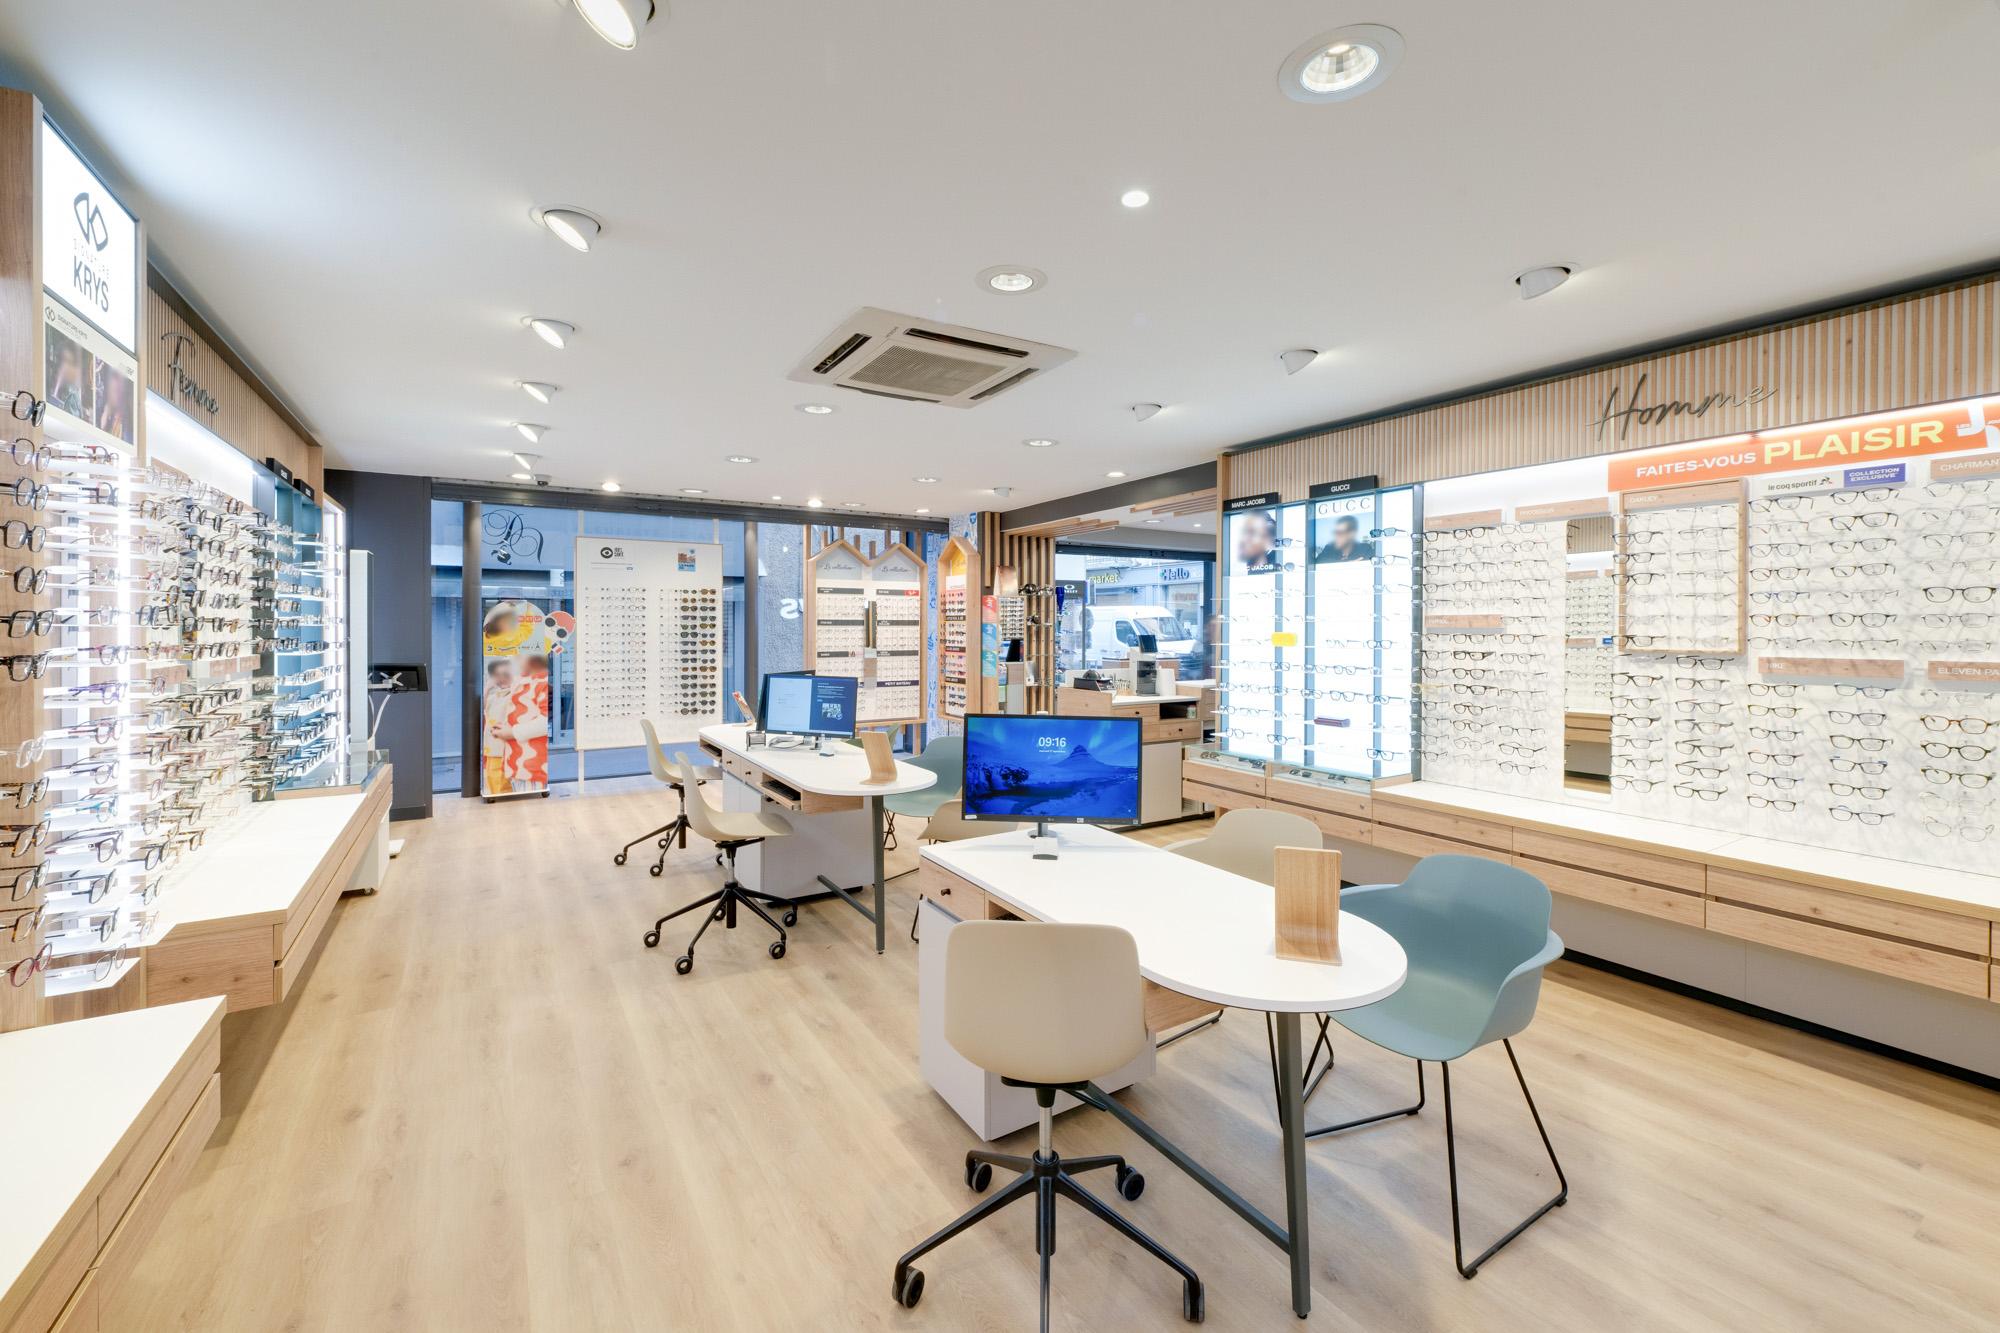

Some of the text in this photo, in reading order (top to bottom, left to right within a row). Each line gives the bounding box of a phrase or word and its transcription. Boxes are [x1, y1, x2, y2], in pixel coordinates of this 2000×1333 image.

[73, 254, 109, 313] KRYS
[1585, 372, 1779, 442] Homme
[1635, 419, 1945, 479] FAITES-VOUS PLAISIR
[1848, 467, 1900, 478] COLLECTION
[1849, 473, 1897, 482] EXCLUSIVE
[1330, 483, 1351, 493] GUCCI
[1767, 478, 1818, 491] le coq sportif
[1231, 498, 1266, 509] MARC JACOBS
[1163, 567, 1190, 581] Hello
[1937, 666, 1981, 676] ELEVEN
[1038, 736, 1067, 748] 09:16
